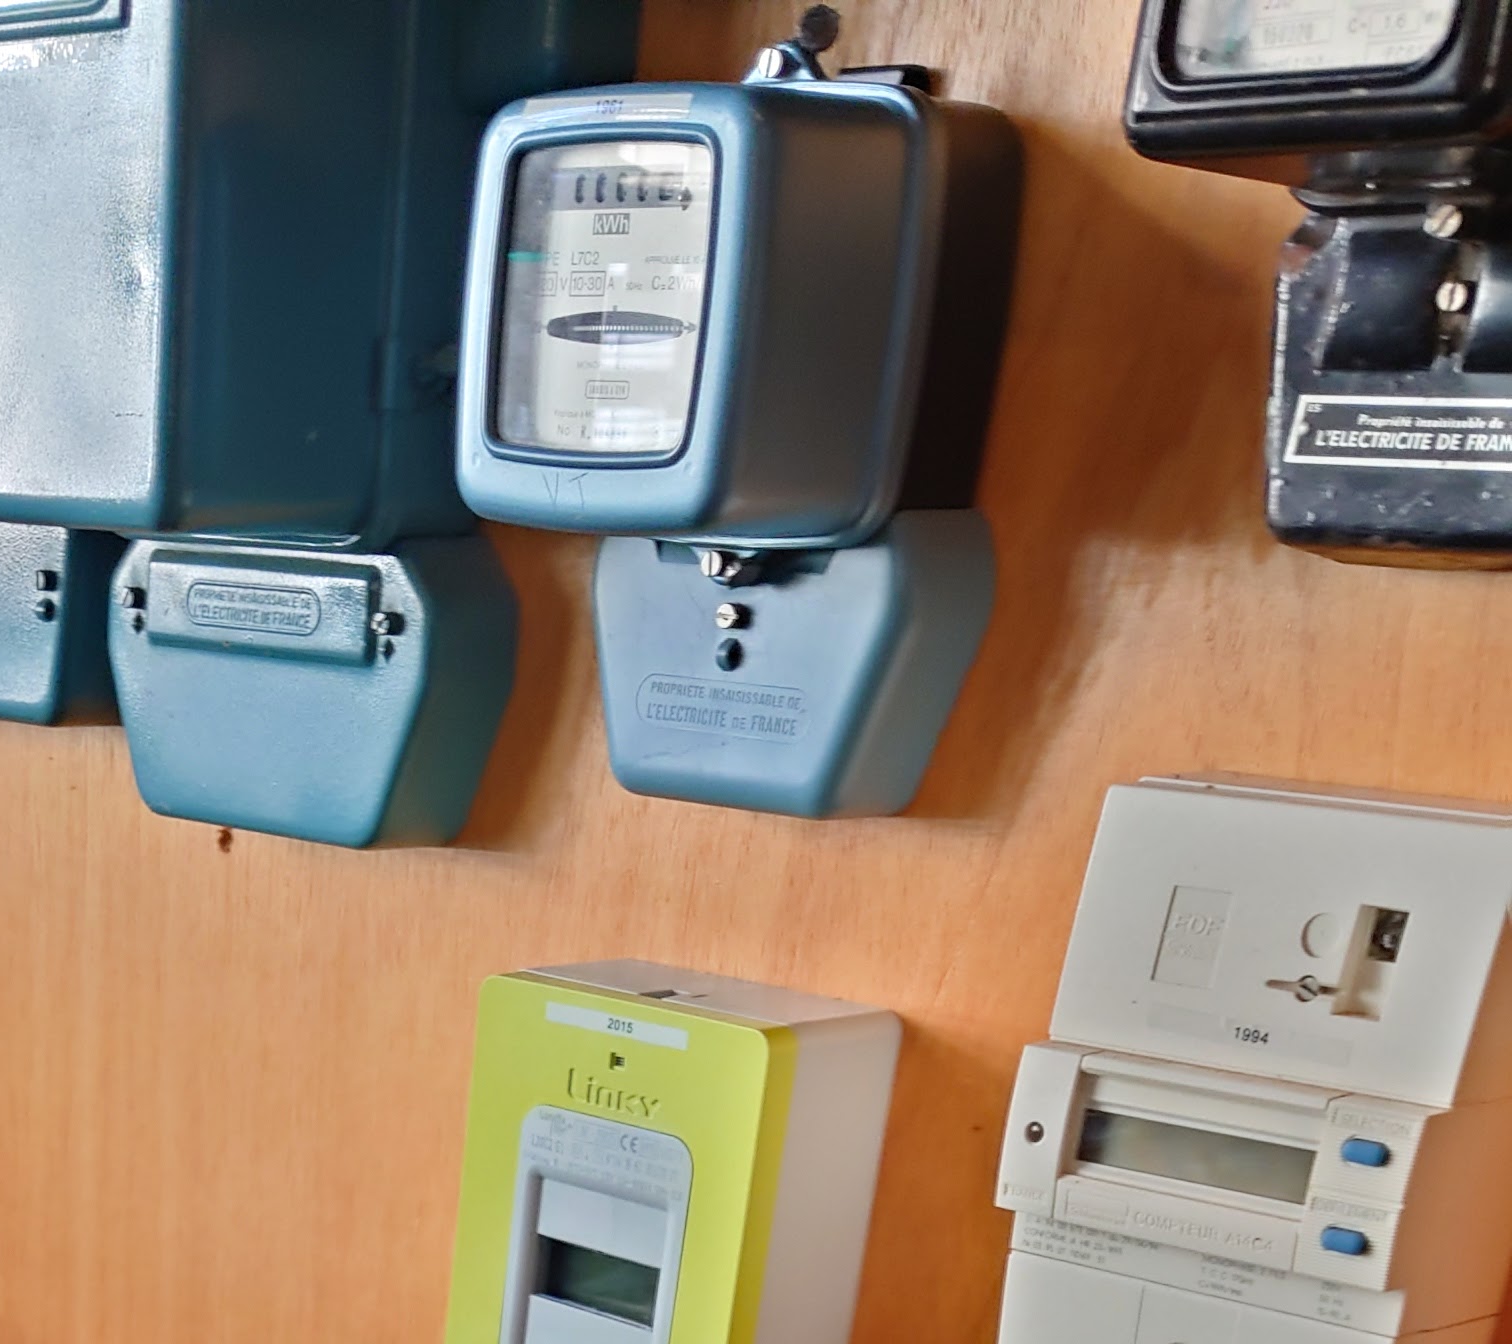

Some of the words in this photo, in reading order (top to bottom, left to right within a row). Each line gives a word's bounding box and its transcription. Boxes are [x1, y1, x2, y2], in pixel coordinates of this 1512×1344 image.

[592, 214, 630, 235] kWh
[571, 277, 603, 291] 10-30
[1315, 430, 1435, 450] L'ELECTRICITE
[1435, 434, 1466, 451] DE
[1465, 434, 1512, 452] FRAN
[650, 681, 705, 699] PROPRIETE
[708, 688, 785, 708] INSAISISSABLE
[646, 703, 728, 728] L'ELECTRICITE
[750, 715, 798, 737] FRANCE
[606, 1017, 635, 1034] 2015
[1234, 1026, 1270, 1045] 1994
